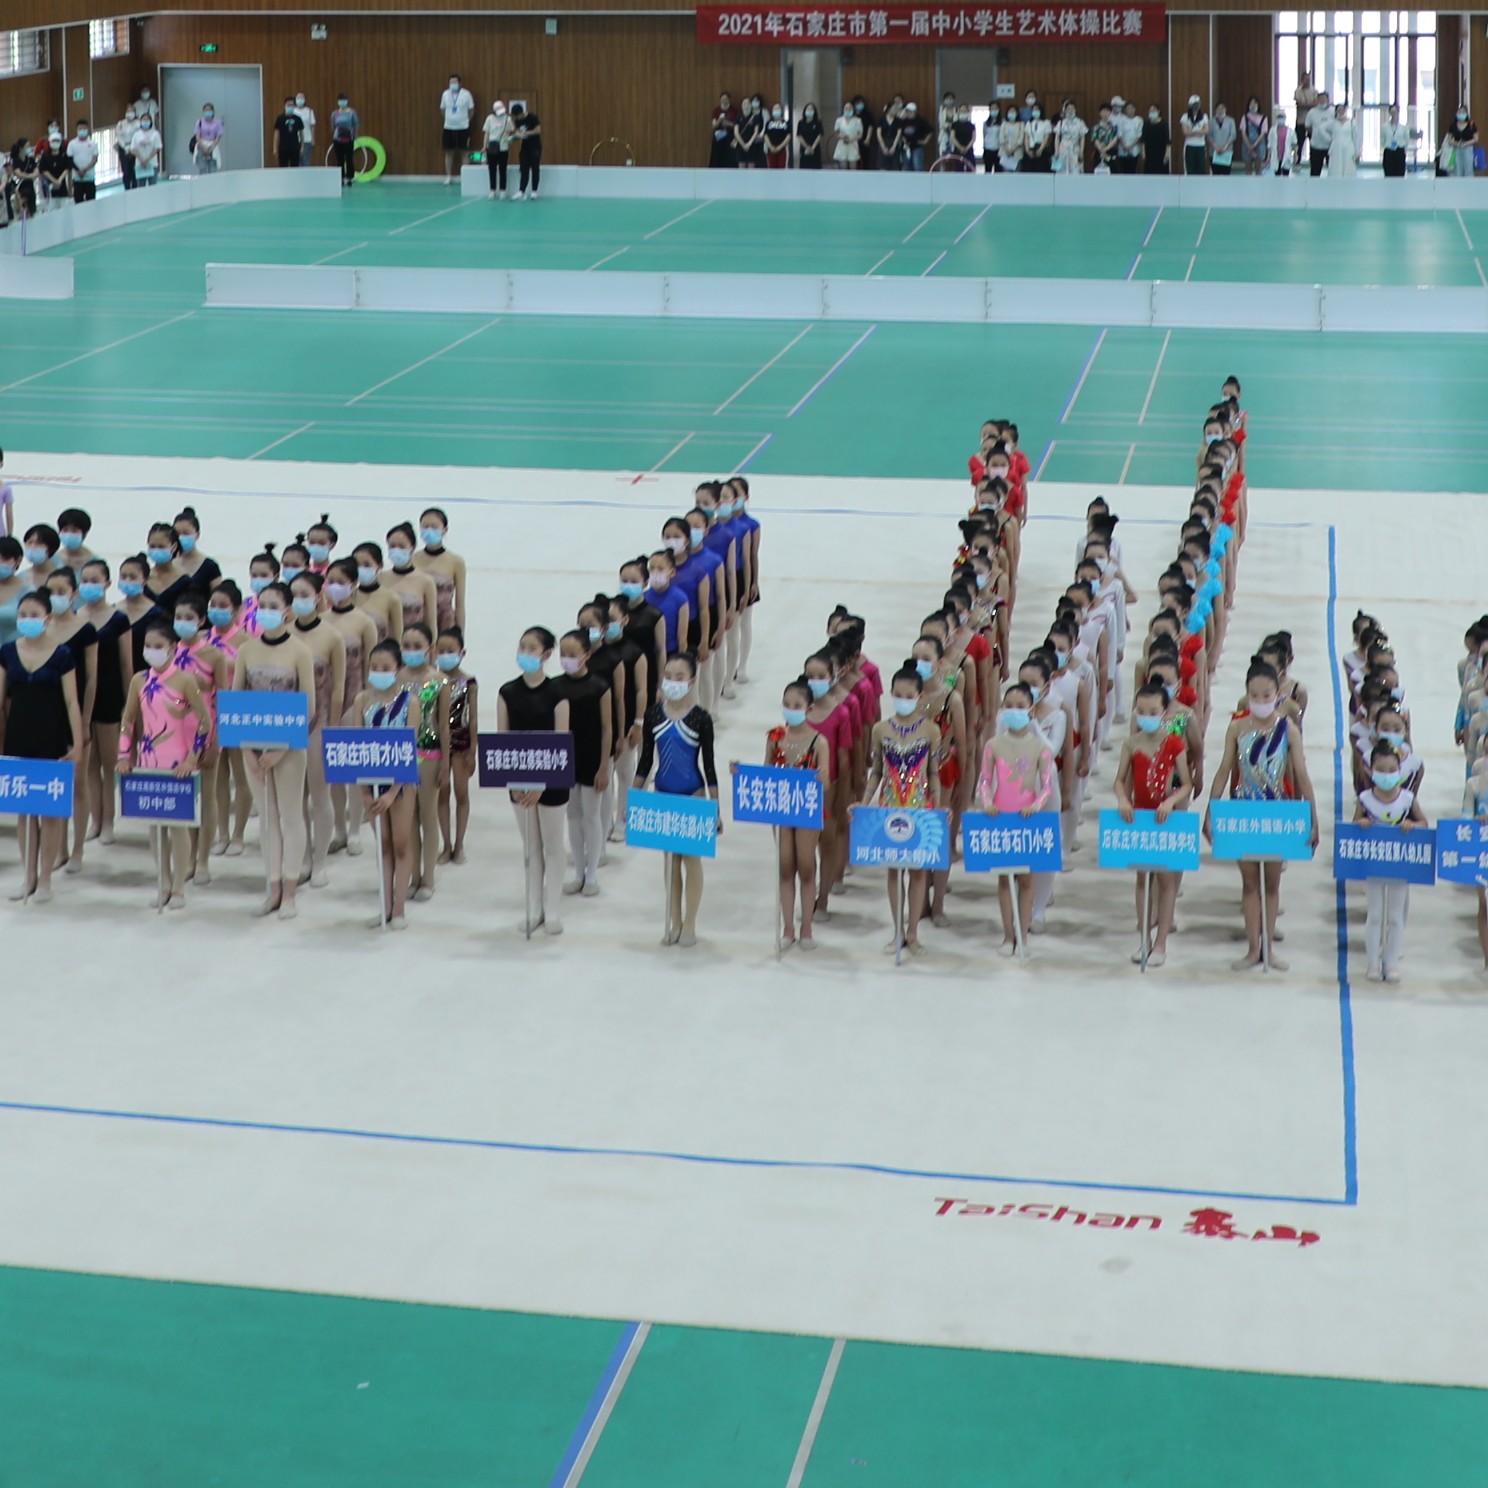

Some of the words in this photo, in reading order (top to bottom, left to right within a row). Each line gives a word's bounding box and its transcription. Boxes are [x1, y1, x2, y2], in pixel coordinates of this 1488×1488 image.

[718, 8, 1143, 38] 2021年石家庄市第一届中小学生艺术体操比赛
[219, 713, 307, 728] 河北正中实验中学
[326, 741, 415, 769] 石家庄市育才小学
[486, 748, 569, 772] 石家庄市立德实验小学
[138, 795, 177, 812] 初中部
[737, 774, 819, 817] 长安东路小学
[628, 806, 715, 843] 石家庄市建华东路小学
[1215, 817, 1306, 835] 石家庄外国语小学
[856, 846, 941, 864] 河北师大附小
[969, 827, 1055, 855] 石家庄市石门小学
[1339, 838, 1432, 866] 石家庄市长安区第八幼儿园
[933, 1195, 1163, 1230] TaiShan
